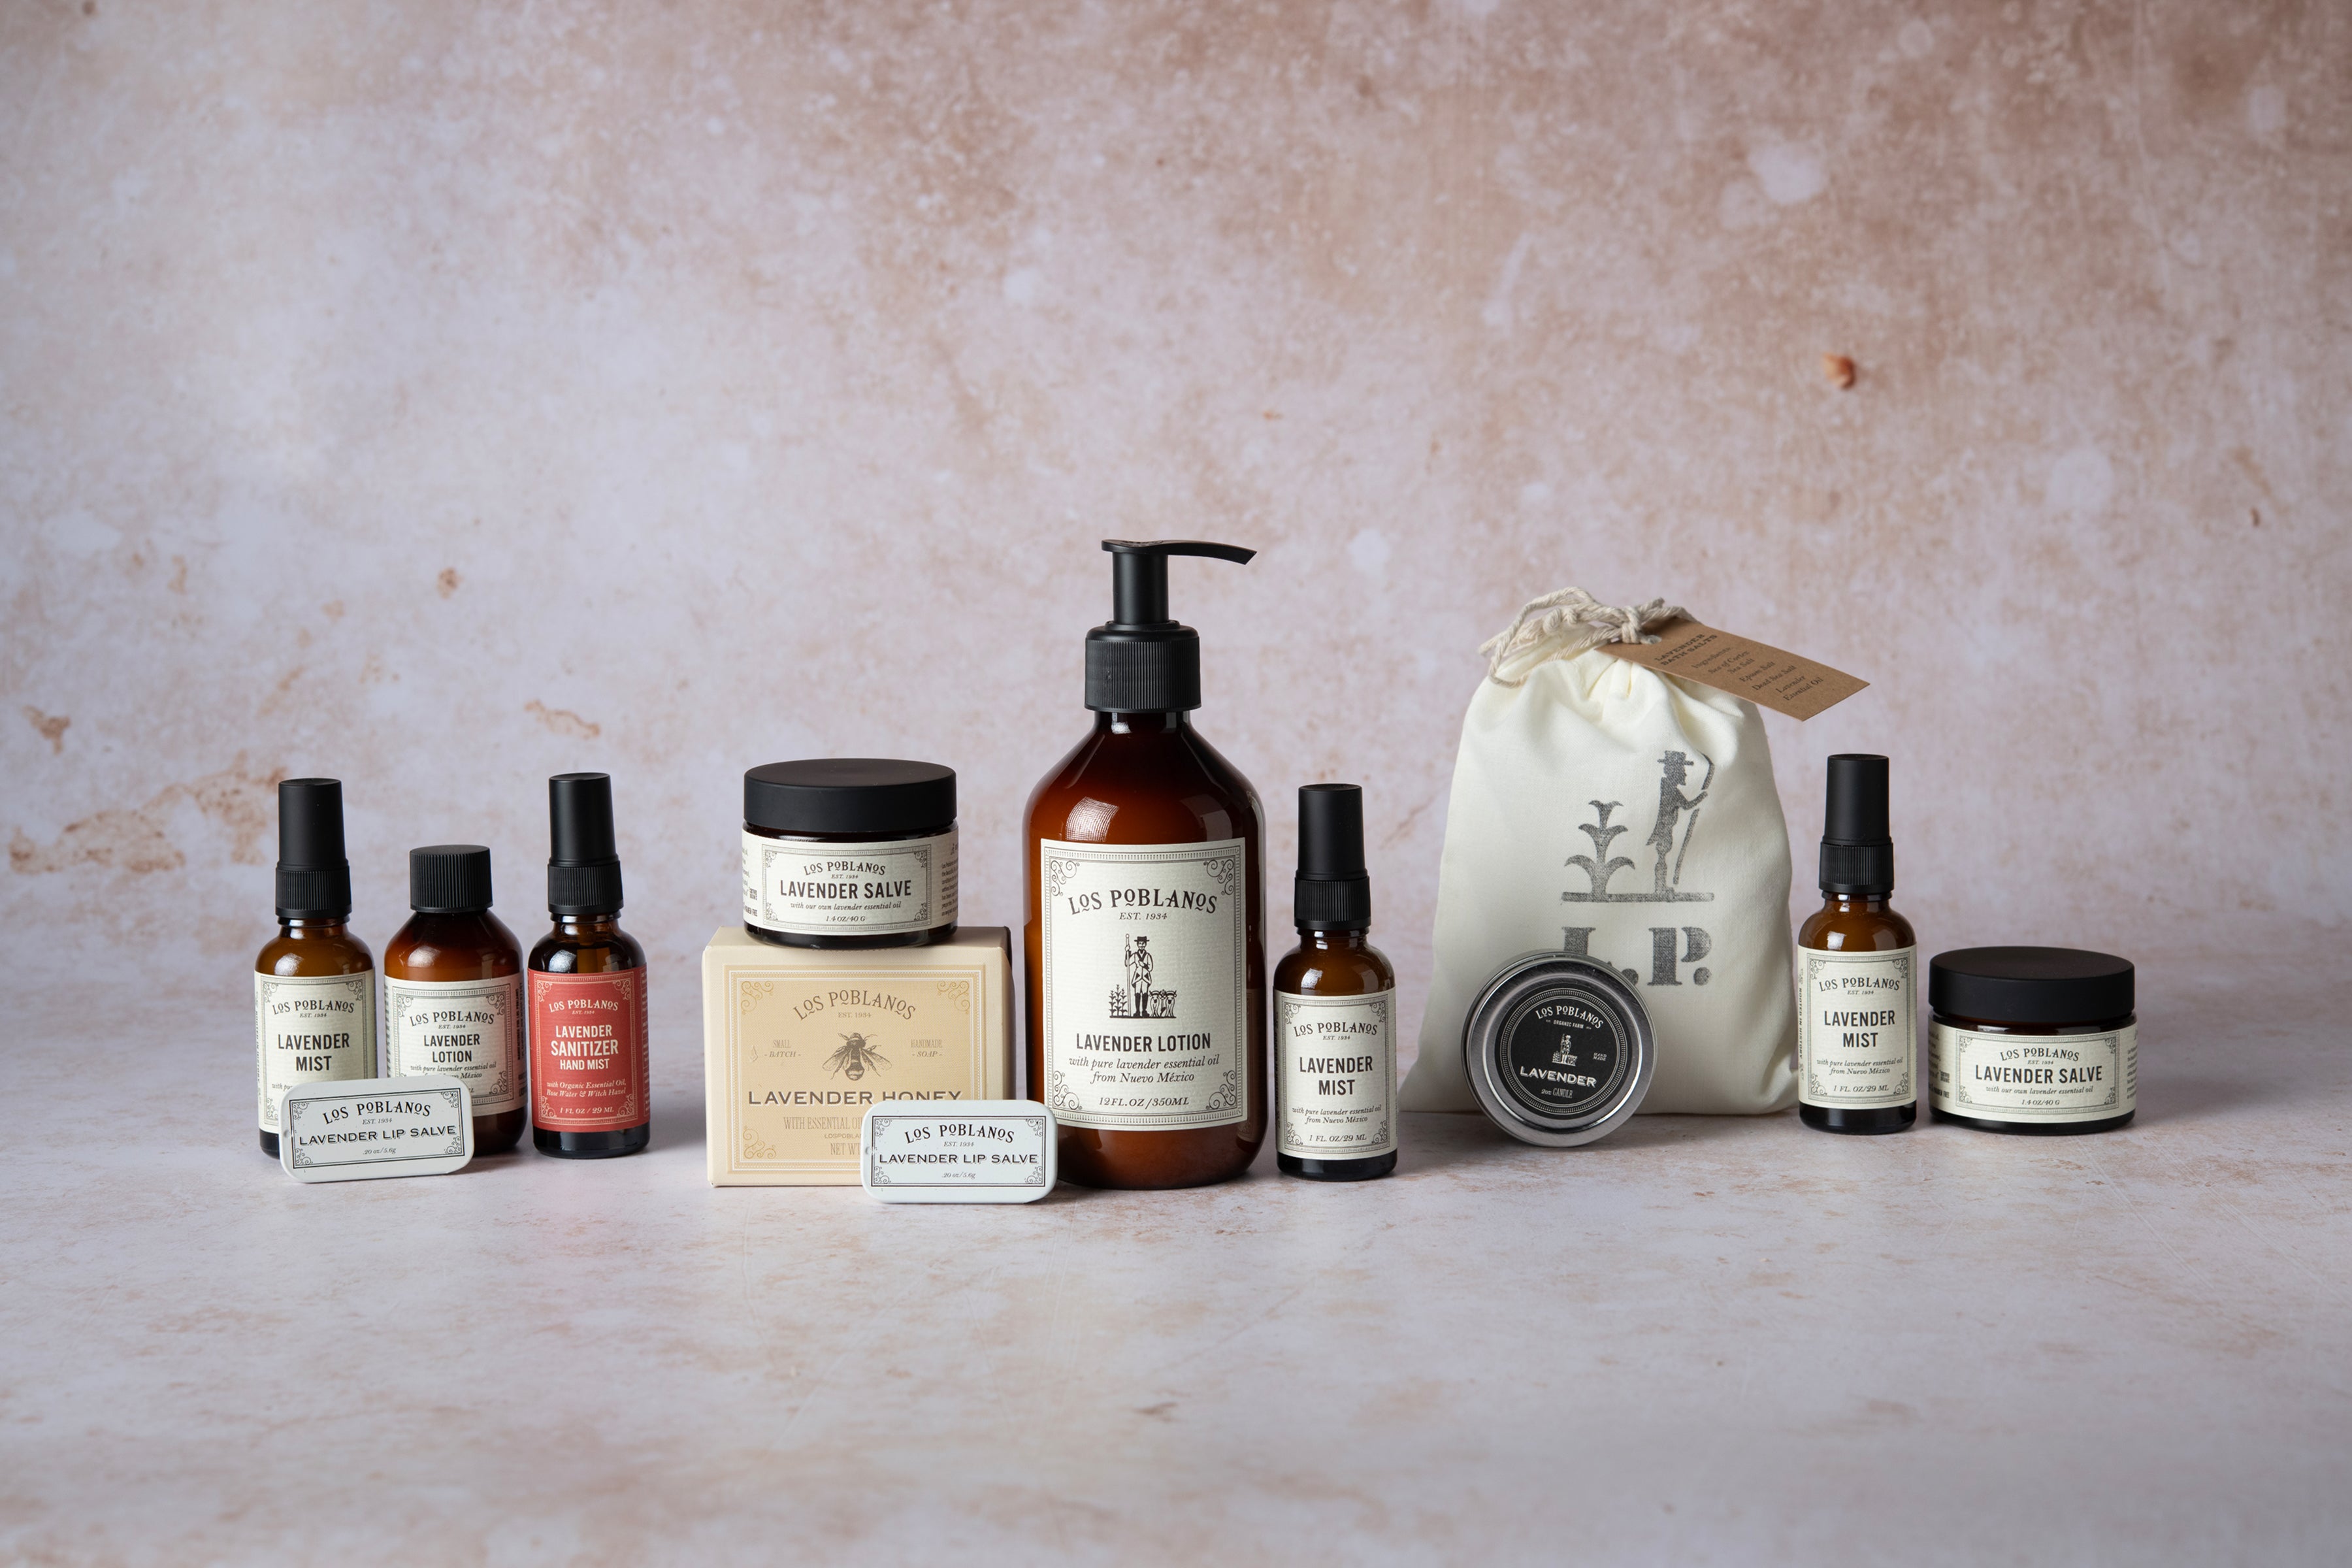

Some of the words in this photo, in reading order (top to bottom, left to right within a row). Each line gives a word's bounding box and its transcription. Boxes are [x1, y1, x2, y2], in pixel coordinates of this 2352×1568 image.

[1654, 634, 1705, 661] LAVENDER
[1661, 651, 1688, 666] BATH
[1688, 634, 1717, 653] SALTS
[1740, 658, 1755, 667] Salt
[1760, 661, 1776, 670] Salt
[1752, 679, 1771, 690] Dead
[1781, 665, 1797, 674] Salt
[1776, 676, 1806, 693] Lavender
[1810, 677, 1823, 685] Oil
[804, 862, 823, 875] LOS
[827, 860, 886, 875] POBLANOS
[780, 879, 858, 899] LAVENDER
[864, 879, 911, 899] SALVE
[864, 902, 891, 910] essential
[1068, 892, 1102, 915] LOS
[1109, 889, 1218, 914] POBLANOS
[1819, 979, 1838, 992] LOS
[1842, 977, 1900, 991] POBLANOS
[272, 1002, 291, 1015] LOS
[294, 1000, 355, 1013] POBLANOS
[549, 1001, 564, 1013] LOS
[568, 999, 619, 1011] POBLANOS
[792, 996, 824, 1021] LOS
[828, 989, 916, 1020] POBLANOS
[410, 1013, 429, 1026] LOS
[433, 1011, 495, 1024] POBLANOS
[1535, 1006, 1553, 1019] LOS
[1556, 1005, 1603, 1028] POBLANOS
[1824, 1010, 1895, 1026] LAVENDER
[556, 1025, 612, 1038] LAVENDER
[1294, 1024, 1313, 1037] LOS
[1317, 1022, 1378, 1035] POBLANOS
[278, 1033, 350, 1050] LAVENDER
[424, 1034, 480, 1047] LAVENDER
[1077, 1033, 1152, 1052] LAVENDER
[1158, 1032, 1211, 1052] LOTION
[1843, 1032, 1878, 1047] MIST
[551, 1039, 619, 1056] SANITIZER
[2000, 1049, 2019, 1061] LOS
[2023, 1048, 2080, 1062] POBLANOS
[296, 1056, 332, 1071] MIST
[433, 1051, 472, 1063] LOTION
[560, 1060, 585, 1070] HAND
[587, 1058, 610, 1070] MIST
[1069, 1056, 1089, 1066] with
[1091, 1060, 1113, 1070] pure
[1117, 1059, 1161, 1069] lavender
[1164, 1056, 1205, 1068] essential
[1207, 1054, 1220, 1066] oil
[1299, 1056, 1373, 1073] LAVENDER
[1090, 1071, 1117, 1085] from
[1120, 1073, 1154, 1083] Nuevo
[1157, 1072, 1195, 1083] México
[1520, 1066, 1597, 1088] LAVENDER
[1975, 1064, 2053, 1084] LAVENDER
[2059, 1065, 2102, 1084] SALVE
[1318, 1079, 1355, 1095] MIST
[1552, 1088, 1573, 1098] CANDLE
[749, 1091, 874, 1105] LAVENDER
[883, 1091, 962, 1100] HONEY
[323, 1107, 349, 1124] LOS
[356, 1101, 431, 1117] POBLANOS
[1350, 1106, 1373, 1115] essential
[783, 1117, 805, 1129] WITH
[808, 1117, 850, 1129] ESSENTIAL
[299, 1131, 378, 1145] LAVENDER
[383, 1129, 405, 1140] LIP
[410, 1125, 457, 1137] SALVE
[904, 1126, 930, 1144] LOS
[939, 1124, 1015, 1143] POBLANOS
[879, 1154, 958, 1164] LAVENDER
[963, 1154, 987, 1164] LIP
[991, 1154, 1038, 1164] SALVE
